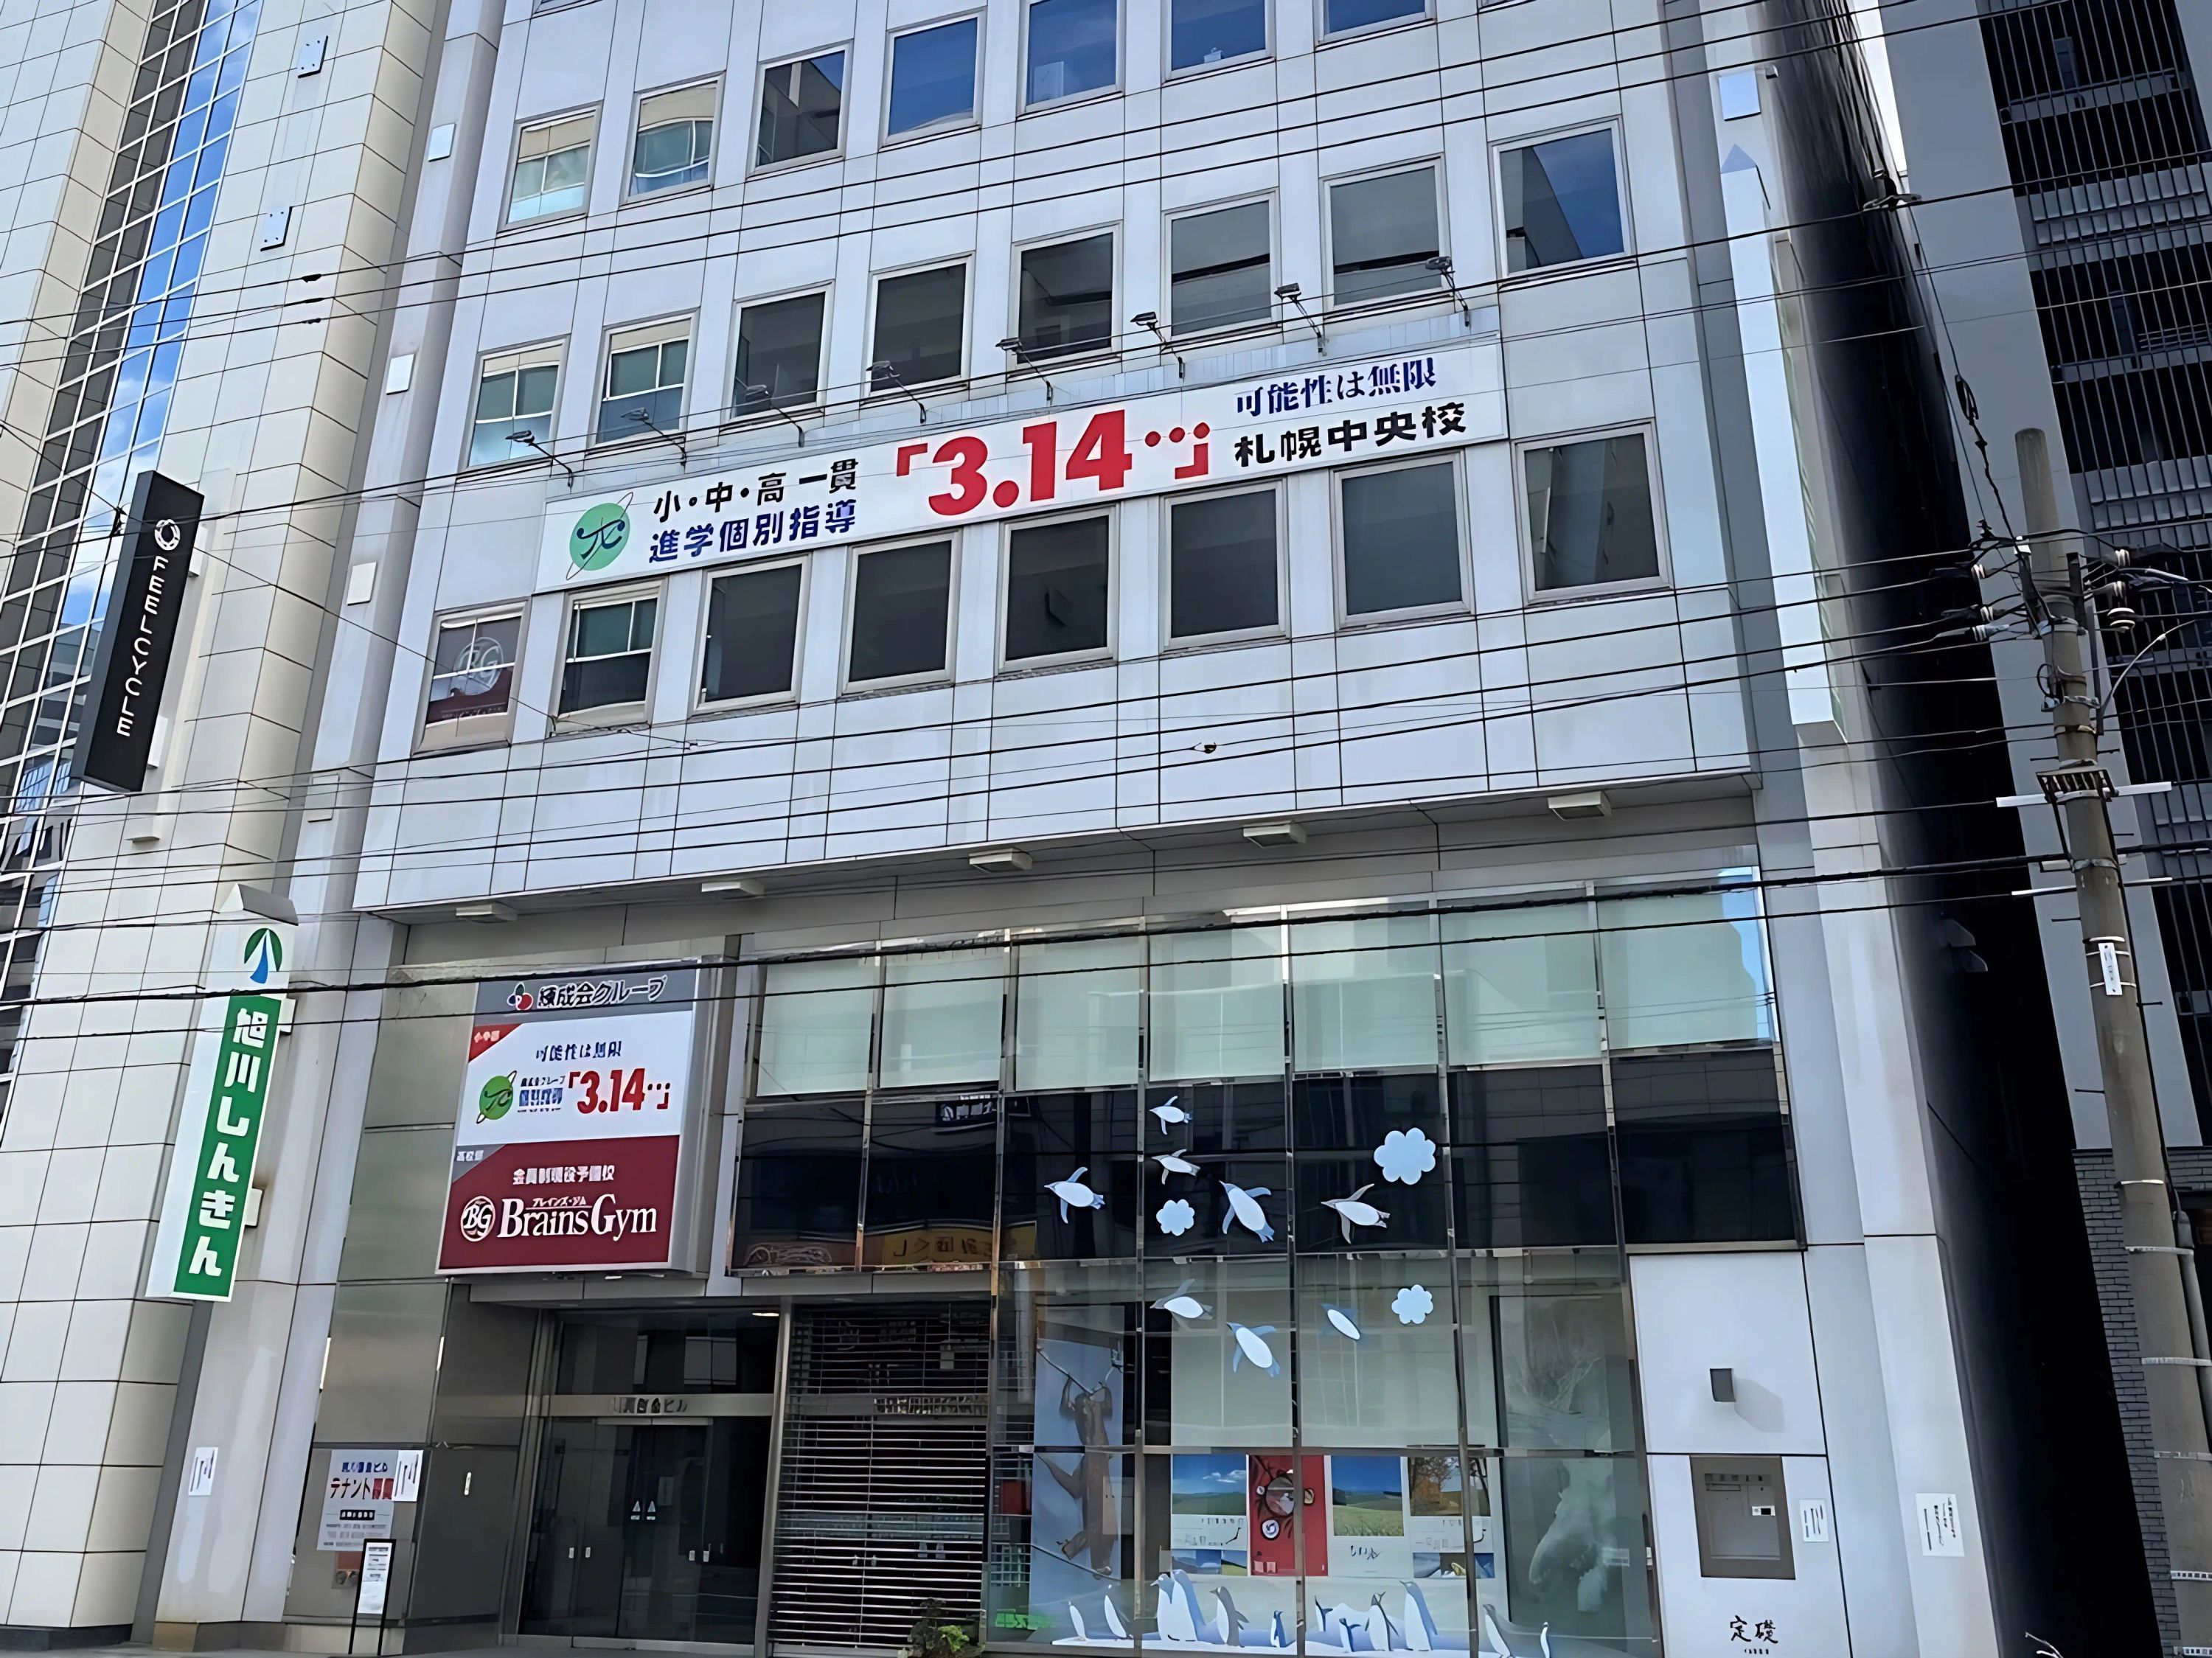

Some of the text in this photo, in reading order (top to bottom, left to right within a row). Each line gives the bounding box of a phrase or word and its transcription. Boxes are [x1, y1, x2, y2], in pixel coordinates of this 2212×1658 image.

[1236, 357, 1436, 416] 可能性は無限
[1234, 402, 1467, 467] 札幌中央校
[649, 499, 857, 563] 進学個別指導
[116, 555, 169, 737] FEELCYCLE
[188, 1007, 269, 1277] 旭川しんきん
[1729, 1615, 1778, 1645] 定礎
